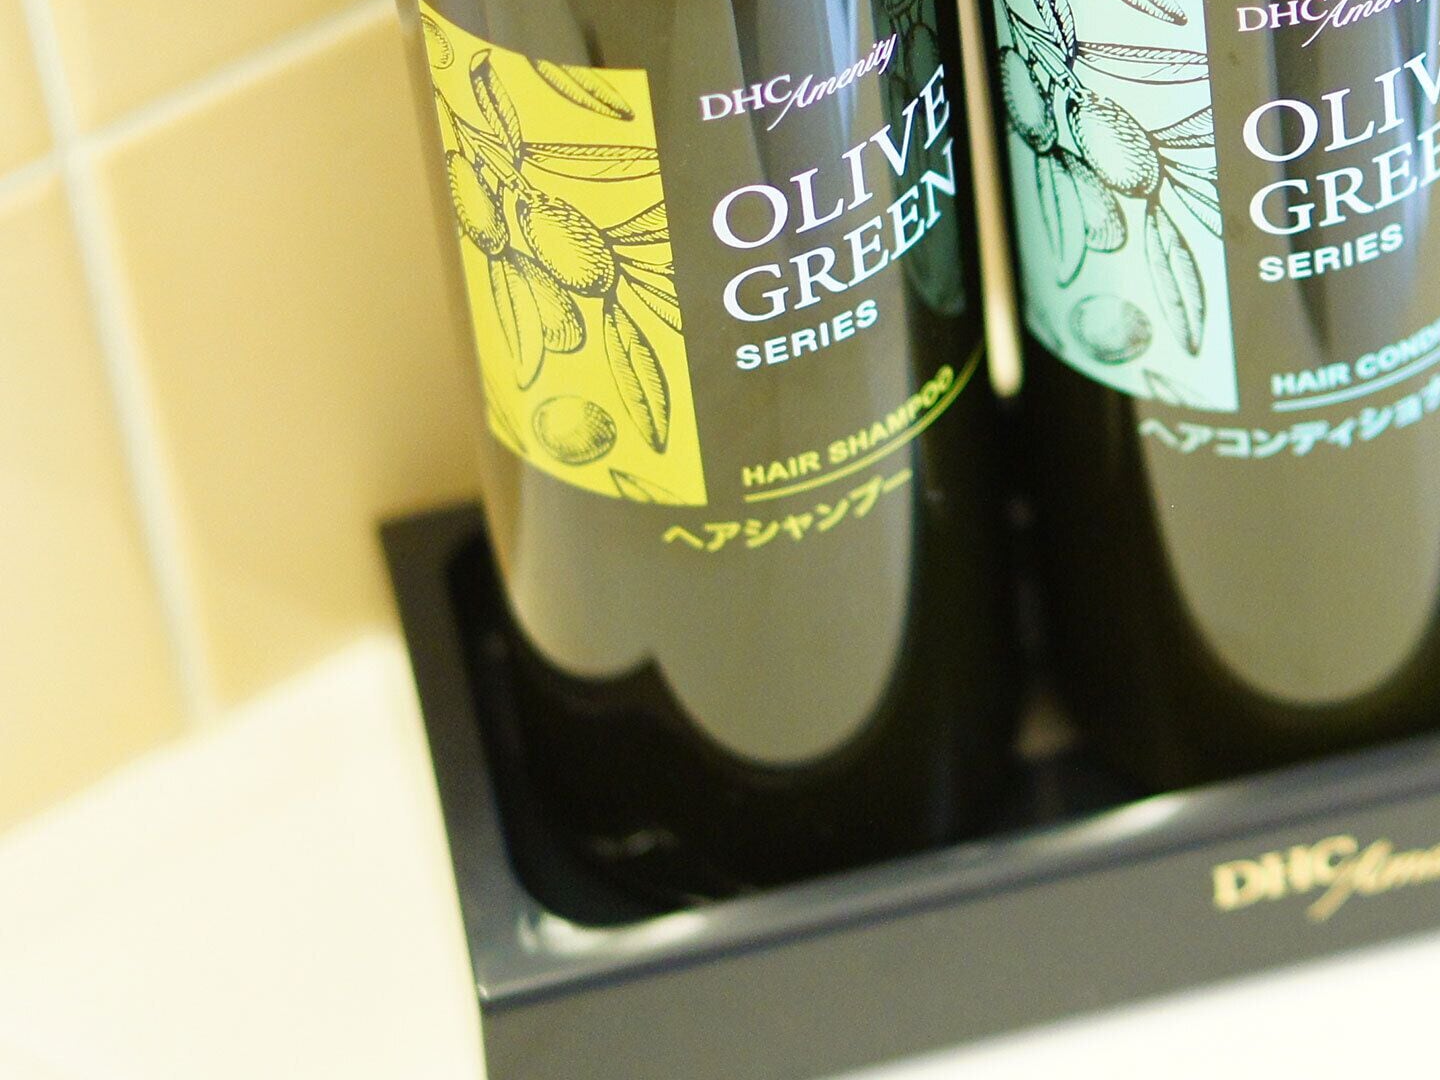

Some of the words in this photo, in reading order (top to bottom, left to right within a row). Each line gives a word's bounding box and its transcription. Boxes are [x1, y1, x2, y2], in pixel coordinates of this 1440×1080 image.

[700, 74, 793, 120] DHC
[766, 33, 898, 131] Amenity
[712, 64, 951, 249] OLIVE
[723, 138, 957, 321] GREEN
[1258, 223, 1405, 283] SERIES
[736, 299, 879, 369] SERIES
[1271, 362, 1352, 397] HAIR
[742, 450, 821, 486] HAIR
[827, 364, 955, 463] SHAMPOO
[662, 469, 913, 552] ヘアシャンプー
